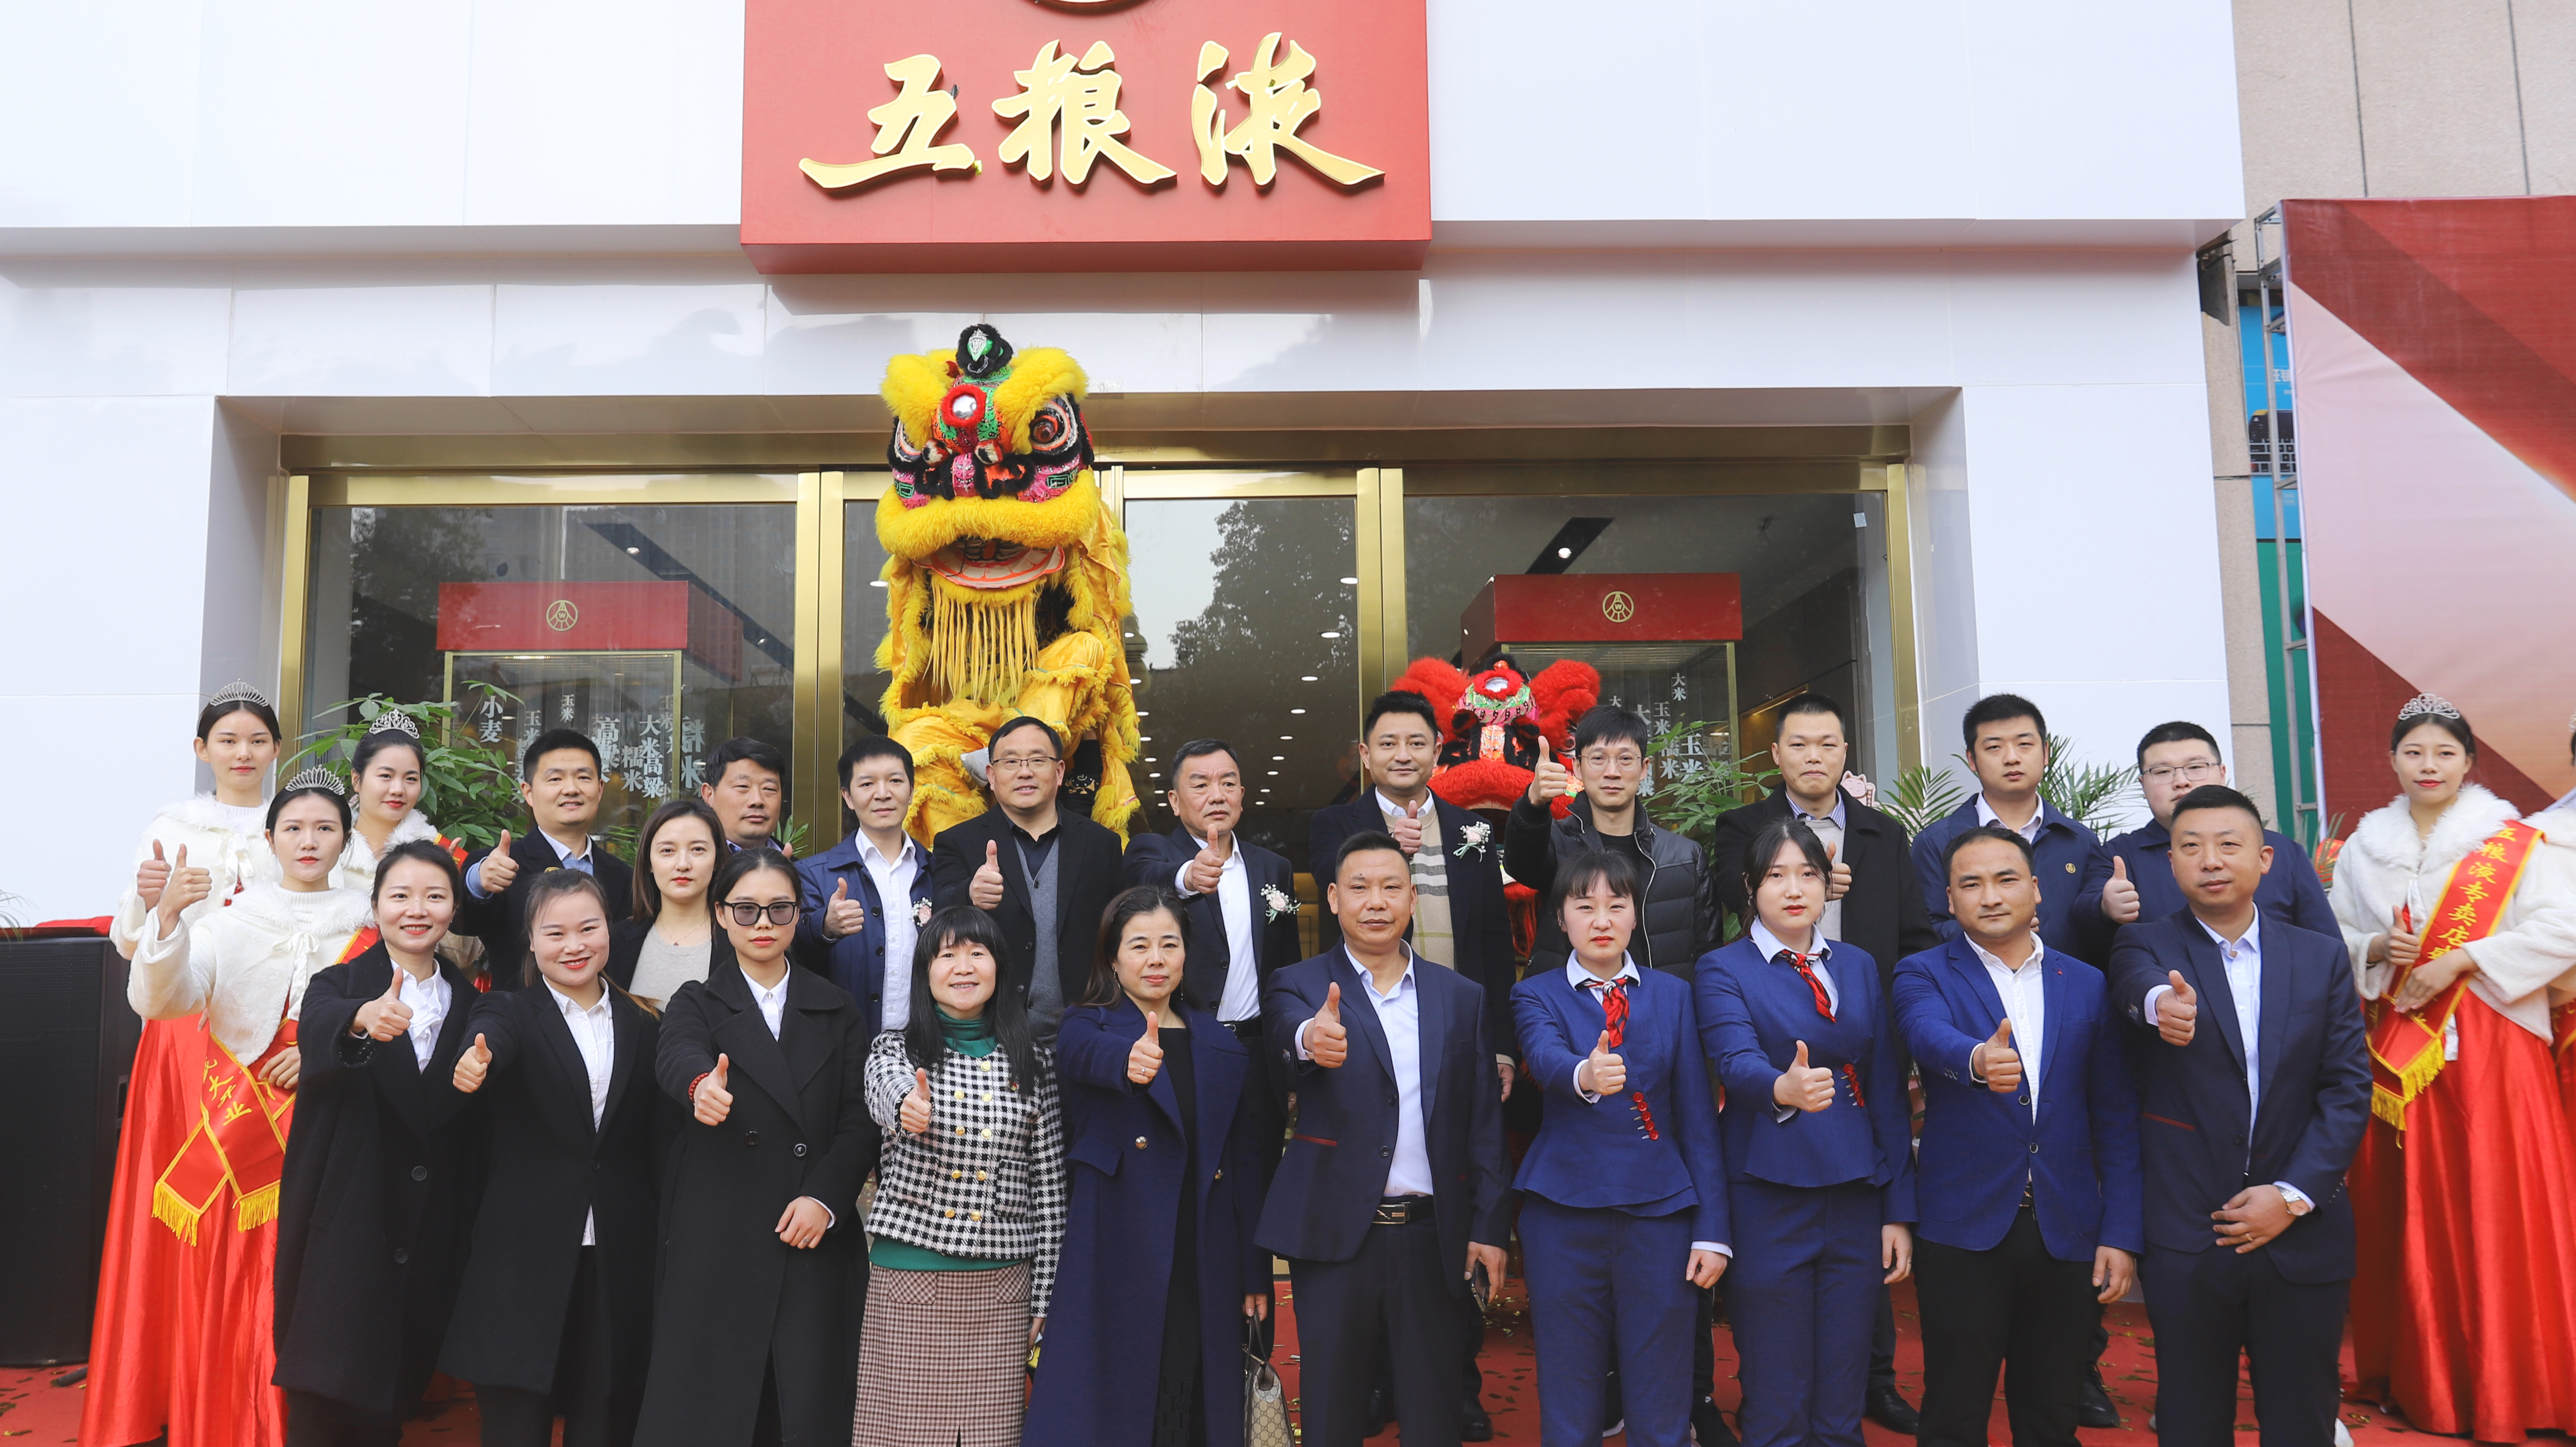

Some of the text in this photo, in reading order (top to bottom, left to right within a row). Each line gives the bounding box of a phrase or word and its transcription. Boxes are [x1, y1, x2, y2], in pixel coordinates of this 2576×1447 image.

[798, 32, 1386, 189] 五粮液
[560, 694, 575, 723] 玉米
[1672, 673, 1687, 701] 大米
[479, 696, 503, 743] 小麦
[639, 714, 661, 757] 大米
[1653, 701, 1671, 735] 玉米
[621, 746, 644, 792] 糯米
[642, 752, 664, 799] 高粱
[1679, 733, 1705, 784] 玉米
